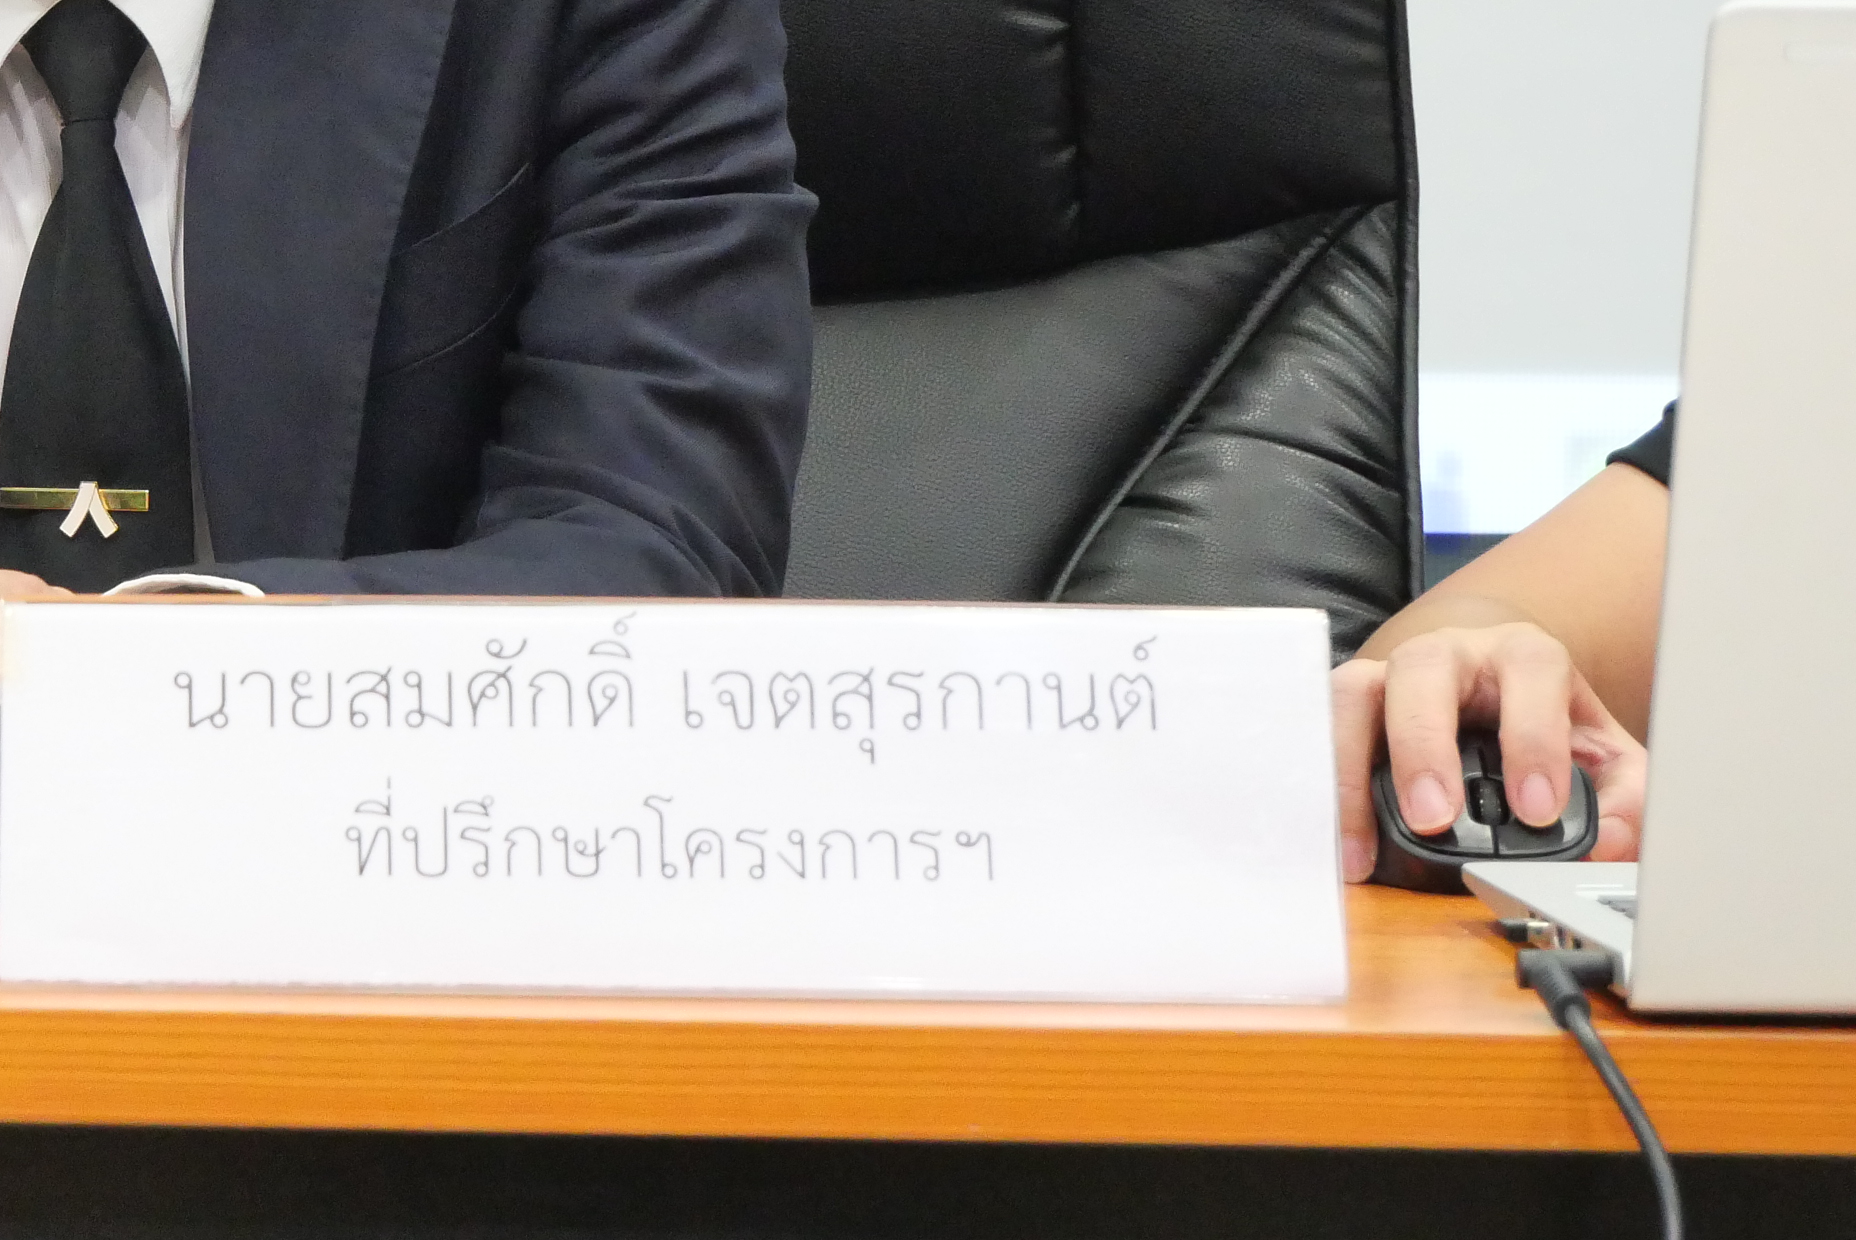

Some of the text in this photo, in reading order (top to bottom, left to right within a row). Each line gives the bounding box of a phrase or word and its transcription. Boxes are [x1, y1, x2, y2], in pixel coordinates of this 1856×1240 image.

[173, 611, 1158, 765] นายสมศักดิ์ เจตสุรกานต์
[344, 776, 995, 882] ที่ปรึกษาโครงการฯ
